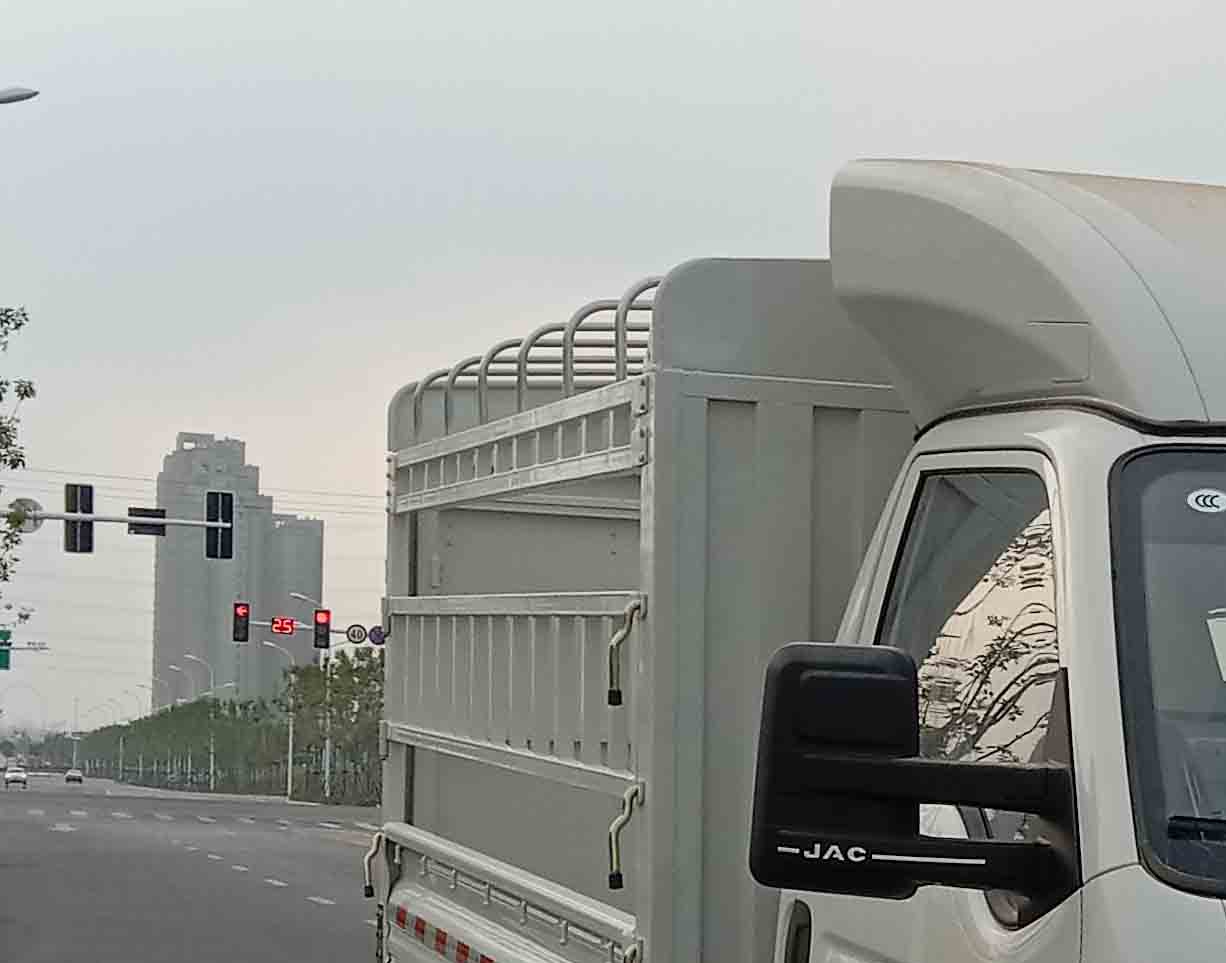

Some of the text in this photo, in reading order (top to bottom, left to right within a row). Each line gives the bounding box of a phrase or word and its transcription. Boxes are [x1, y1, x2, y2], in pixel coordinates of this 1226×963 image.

[1194, 494, 1220, 509] CCC
[272, 618, 293, 634] 25
[803, 843, 867, 862] JAC
